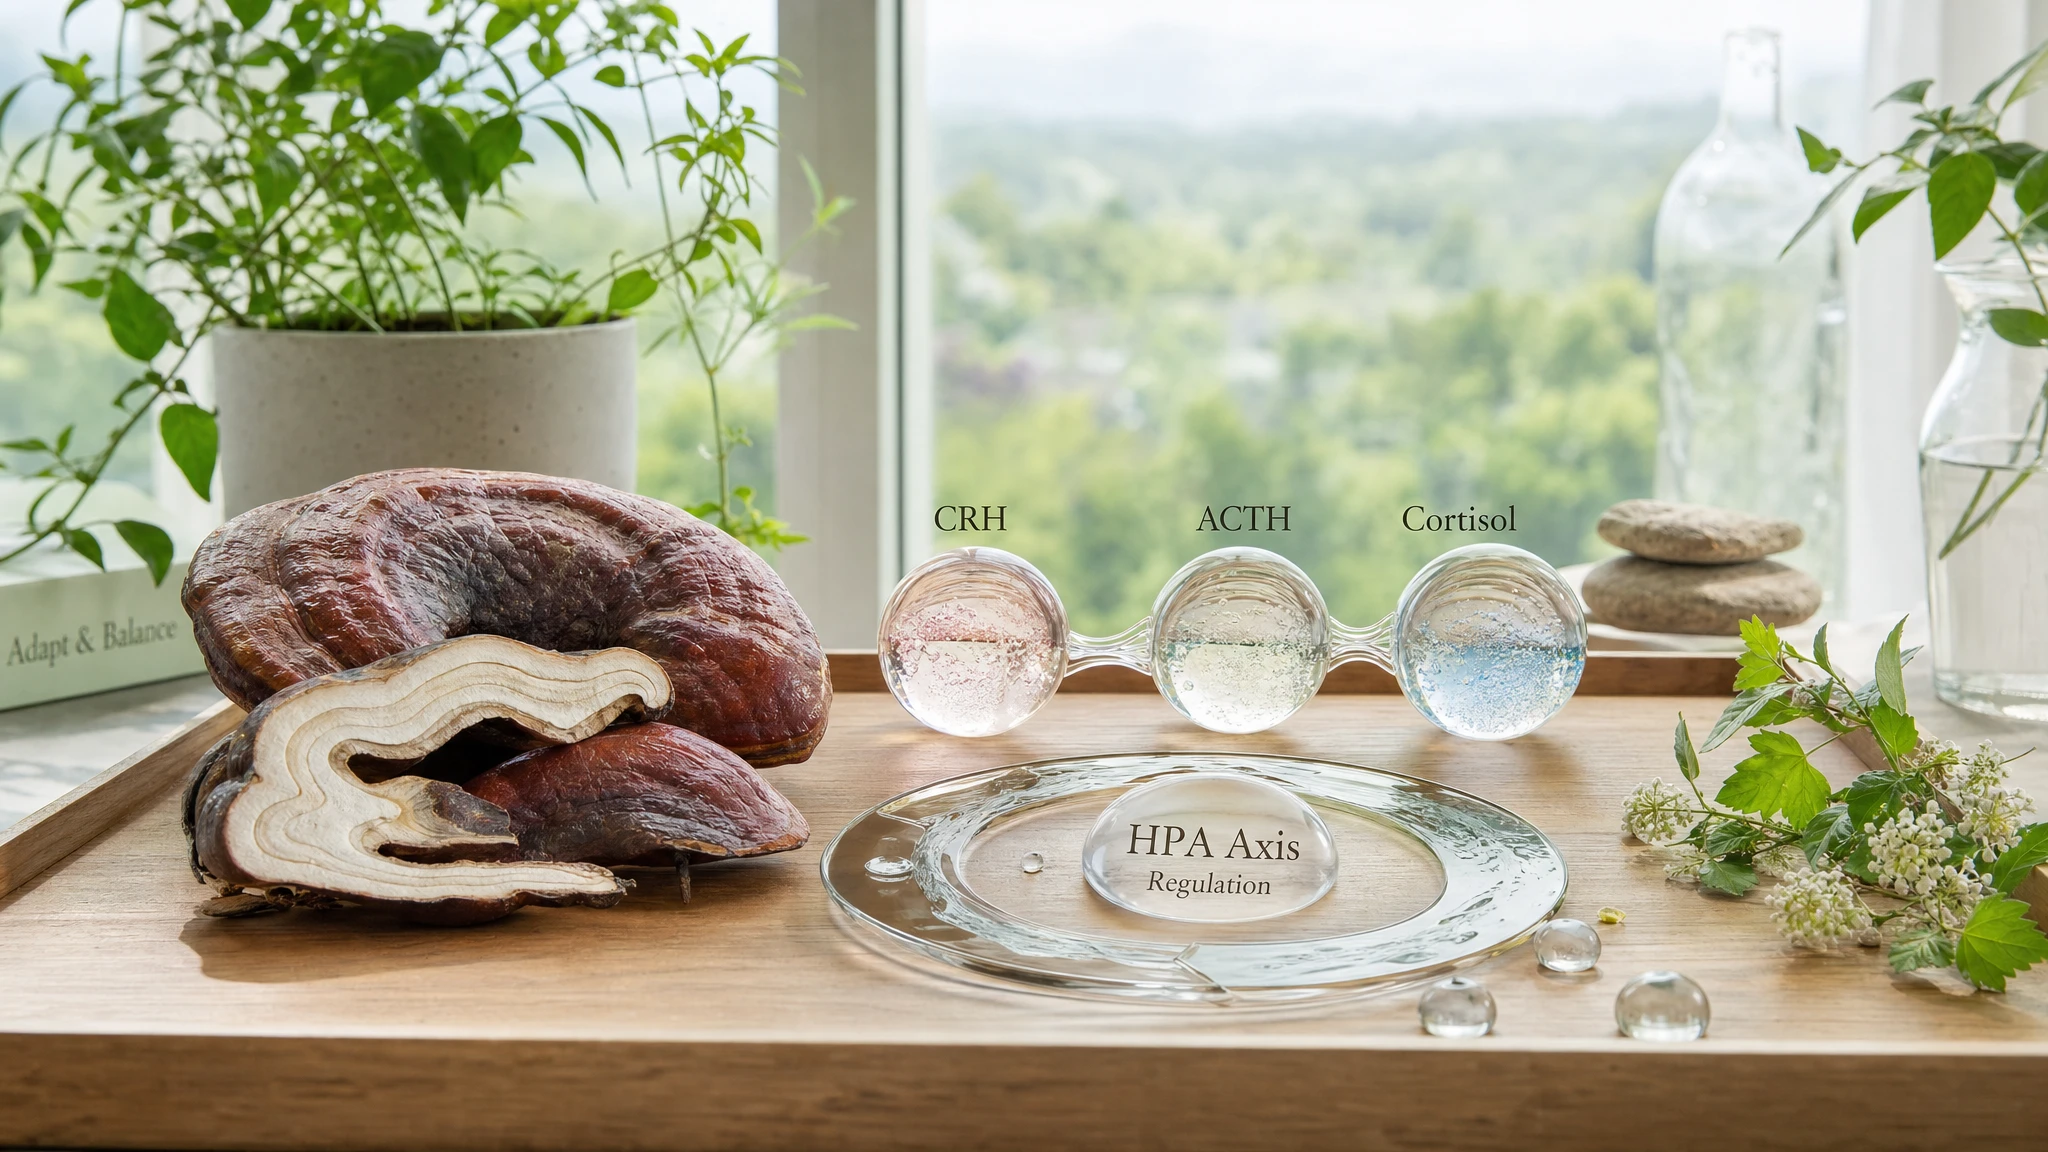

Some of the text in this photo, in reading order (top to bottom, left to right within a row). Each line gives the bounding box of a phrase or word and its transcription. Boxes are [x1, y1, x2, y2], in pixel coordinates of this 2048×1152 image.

[7, 616, 178, 668] Adapt & Balance
[1126, 823, 1301, 861] HPA Axis
[1146, 870, 1272, 899] Regulation
